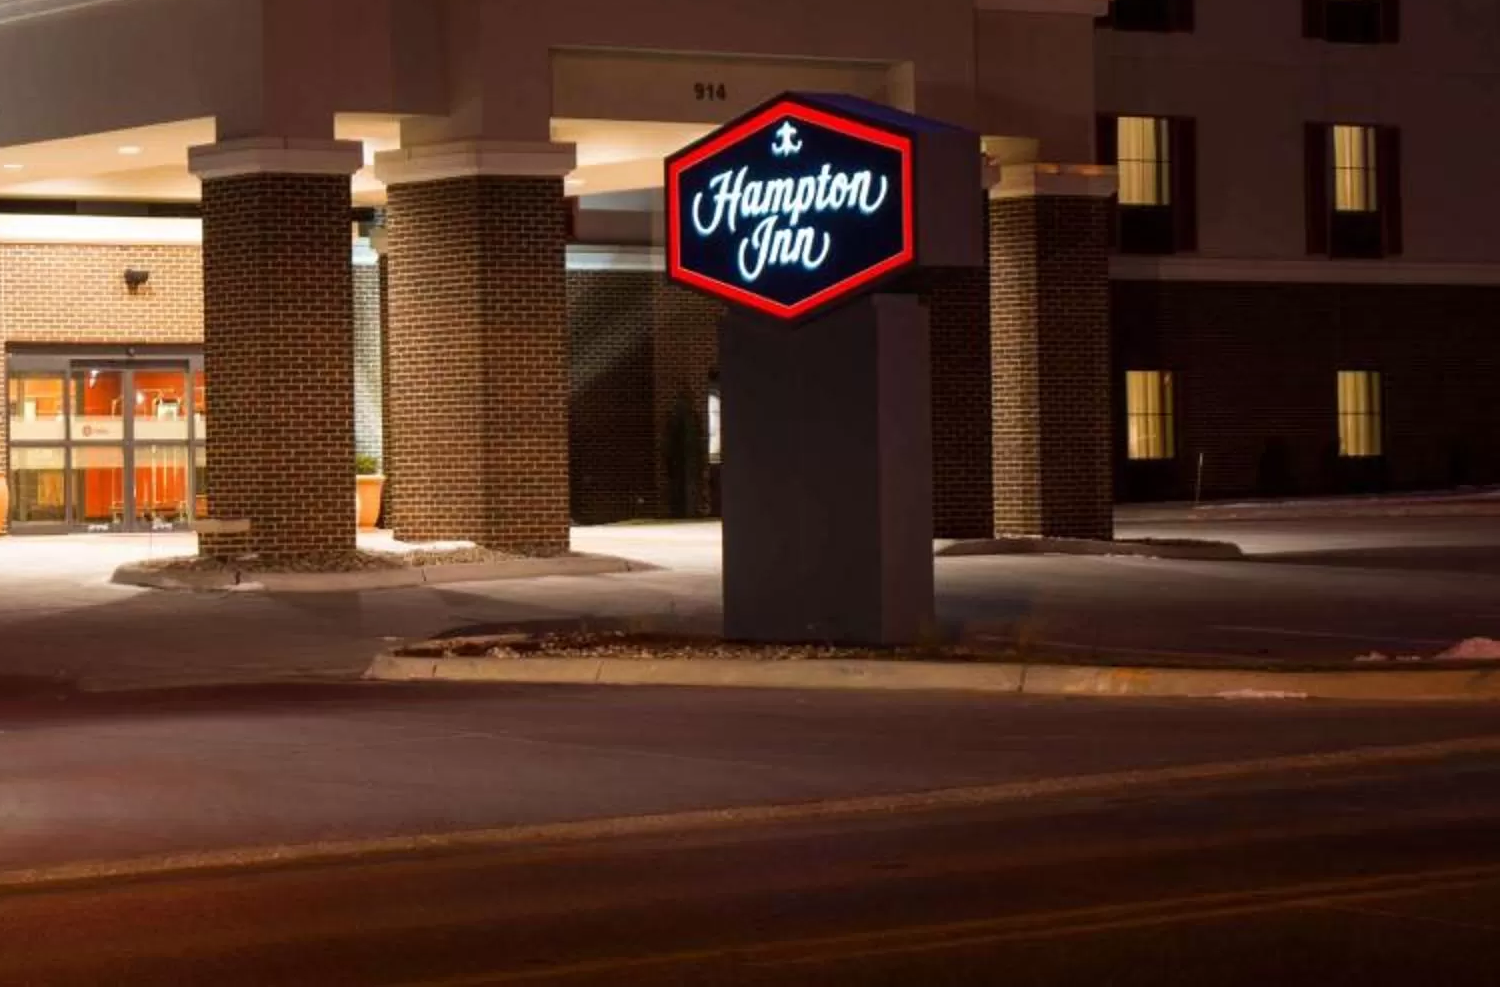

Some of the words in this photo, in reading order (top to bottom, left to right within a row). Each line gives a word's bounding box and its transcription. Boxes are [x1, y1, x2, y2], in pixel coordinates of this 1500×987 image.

[693, 82, 726, 101] 914
[692, 162, 888, 236] Hampton
[737, 214, 831, 282] Inn
